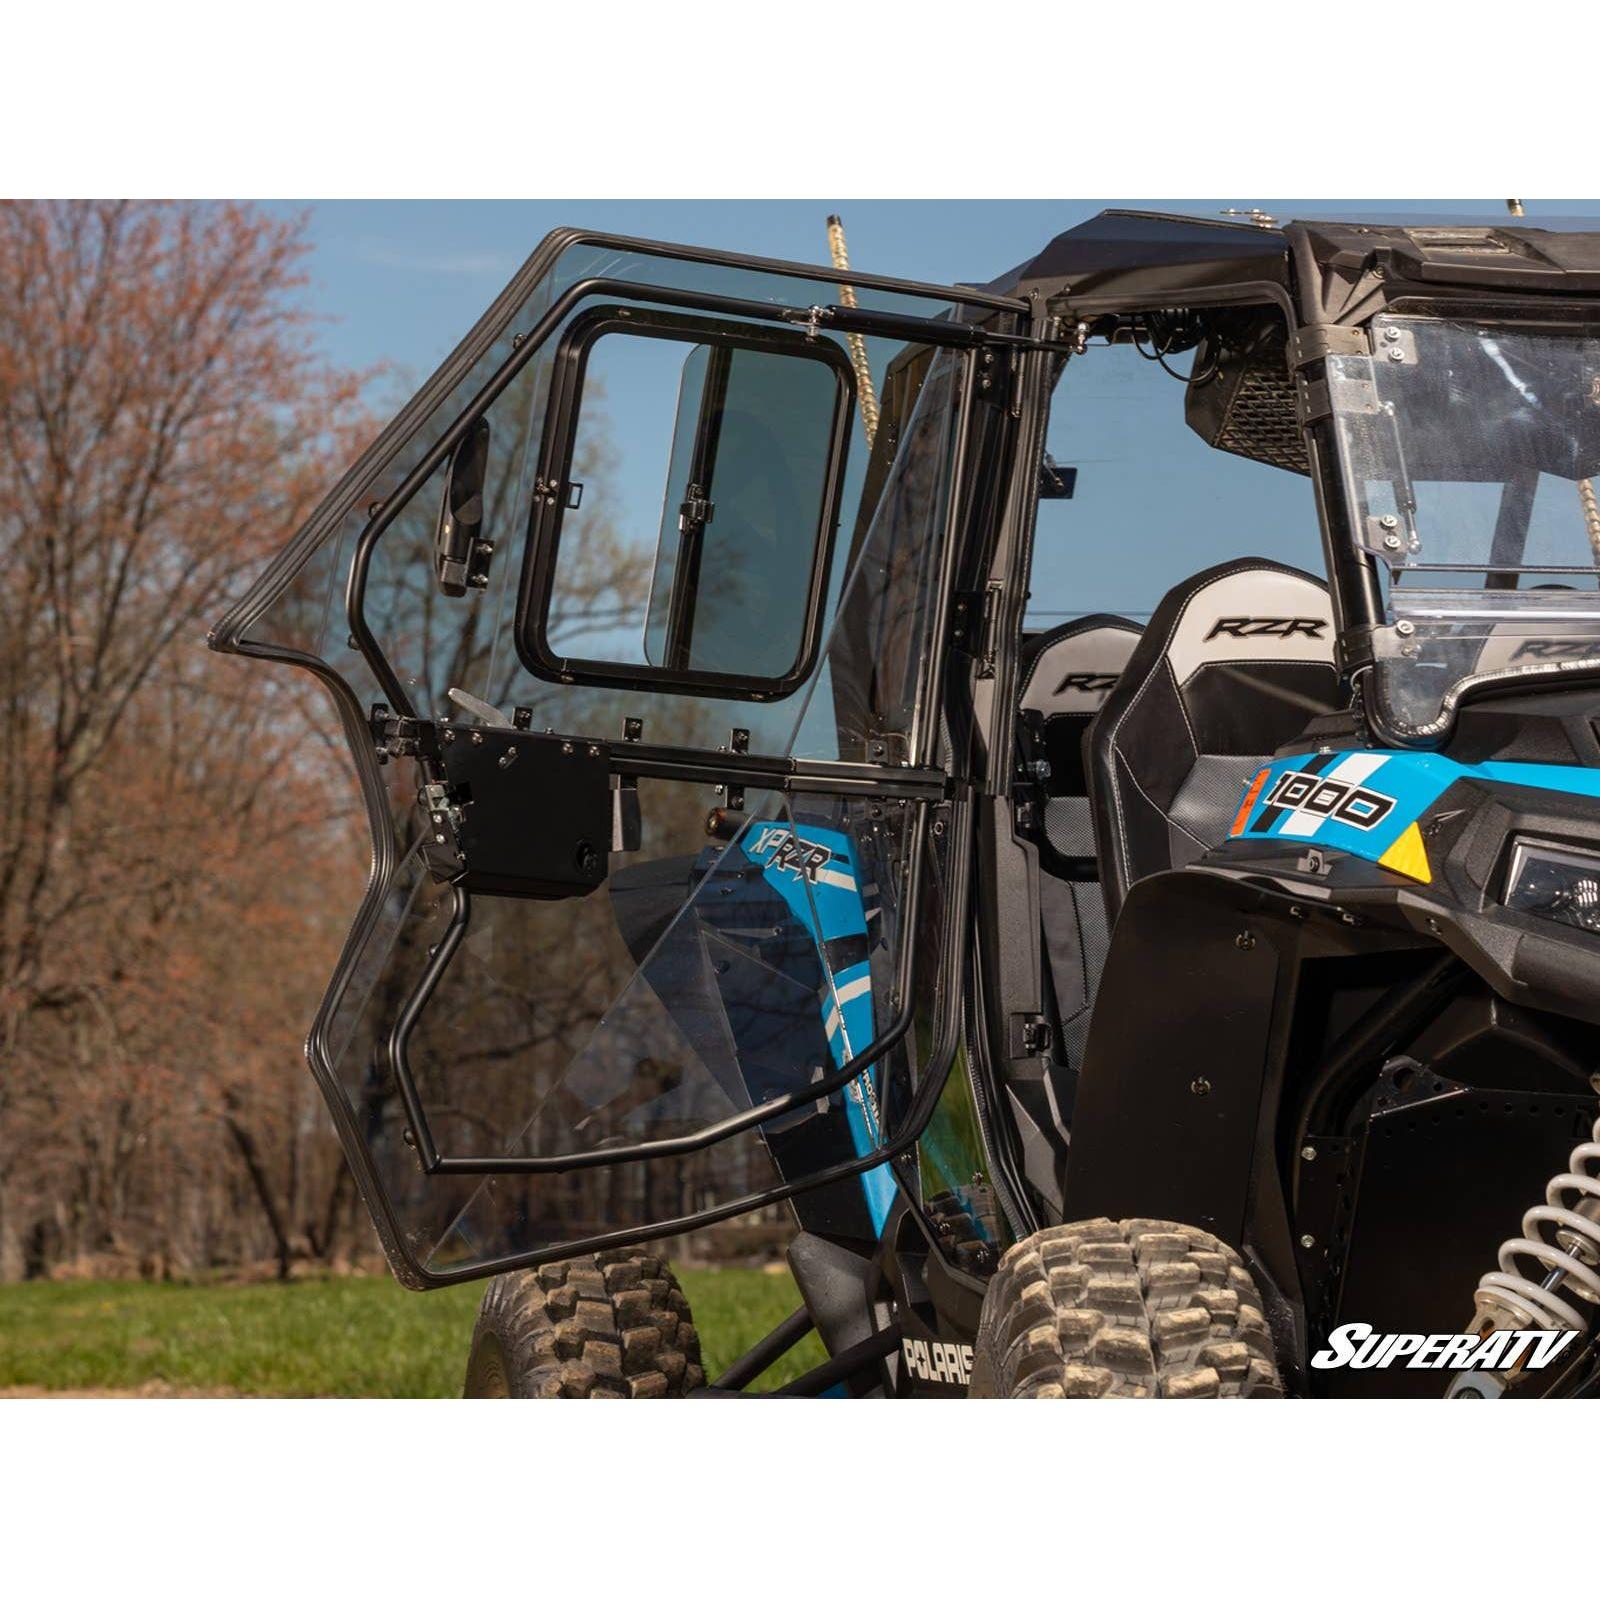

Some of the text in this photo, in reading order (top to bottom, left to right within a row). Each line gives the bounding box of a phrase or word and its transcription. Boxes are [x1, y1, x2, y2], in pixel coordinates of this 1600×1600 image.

[1203, 616, 1329, 642] RZR
[1053, 672, 1121, 696] RZ
[1263, 770, 1398, 831] 1000
[902, 1338, 975, 1385] POLARIS
